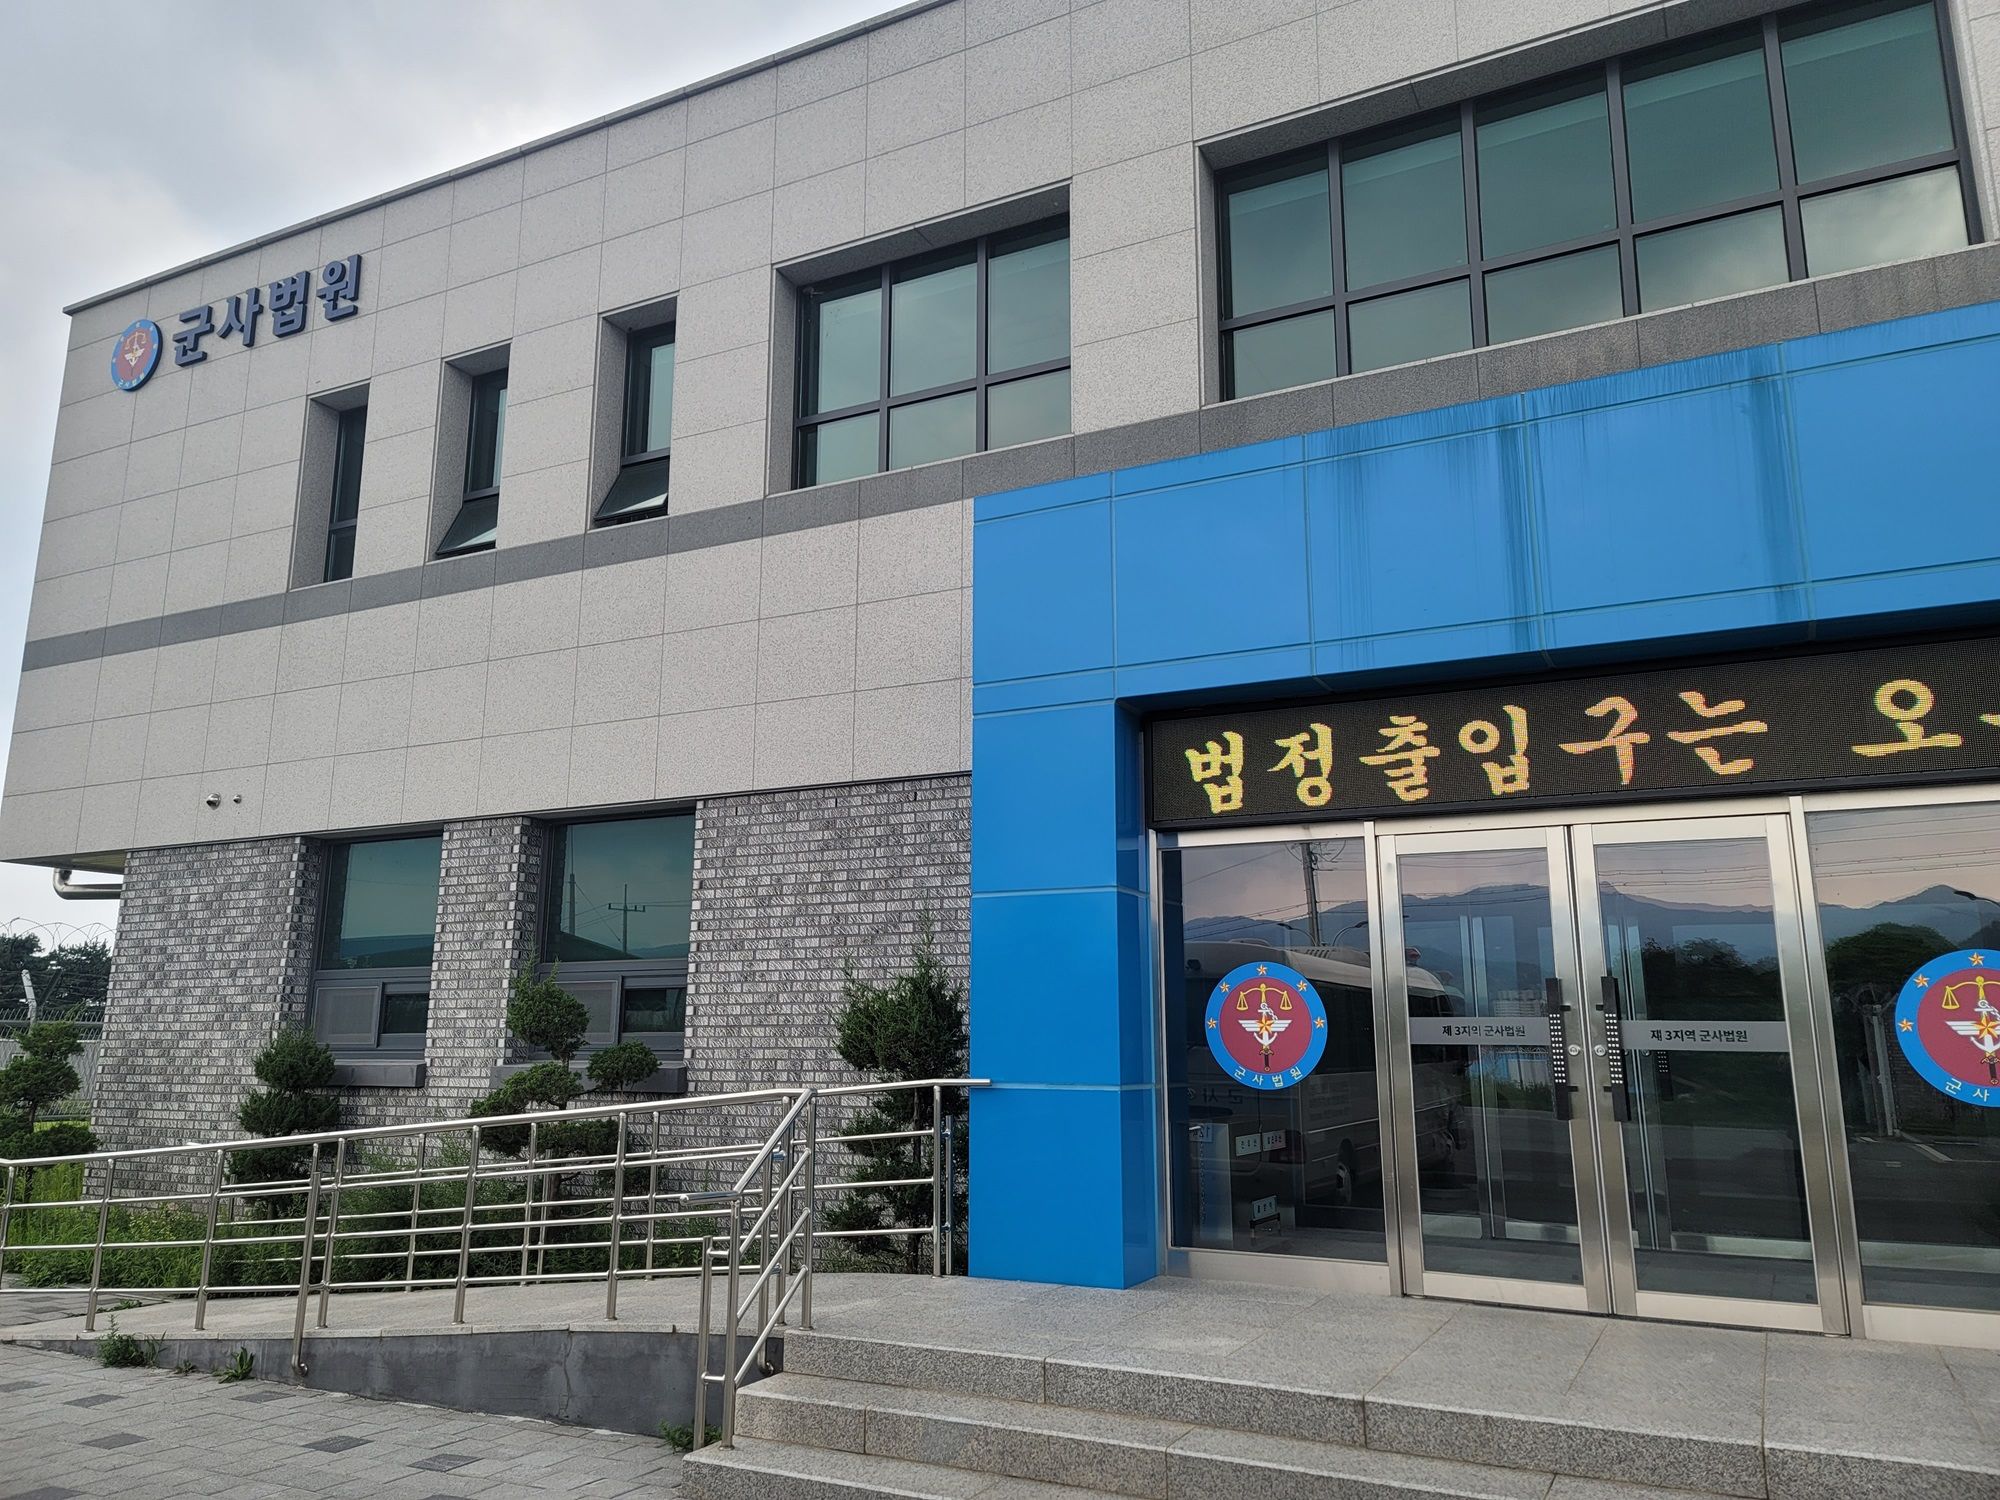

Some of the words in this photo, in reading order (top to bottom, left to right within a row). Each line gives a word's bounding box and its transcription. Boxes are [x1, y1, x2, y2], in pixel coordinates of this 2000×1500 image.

[173, 254, 362, 367] 군사법원
[1851, 678, 2000, 757] 오
[1484, 1025, 1525, 1036] 군사법원
[1699, 1030, 1747, 1043] 군사법원
[1234, 1065, 1303, 1088] 군사법원
